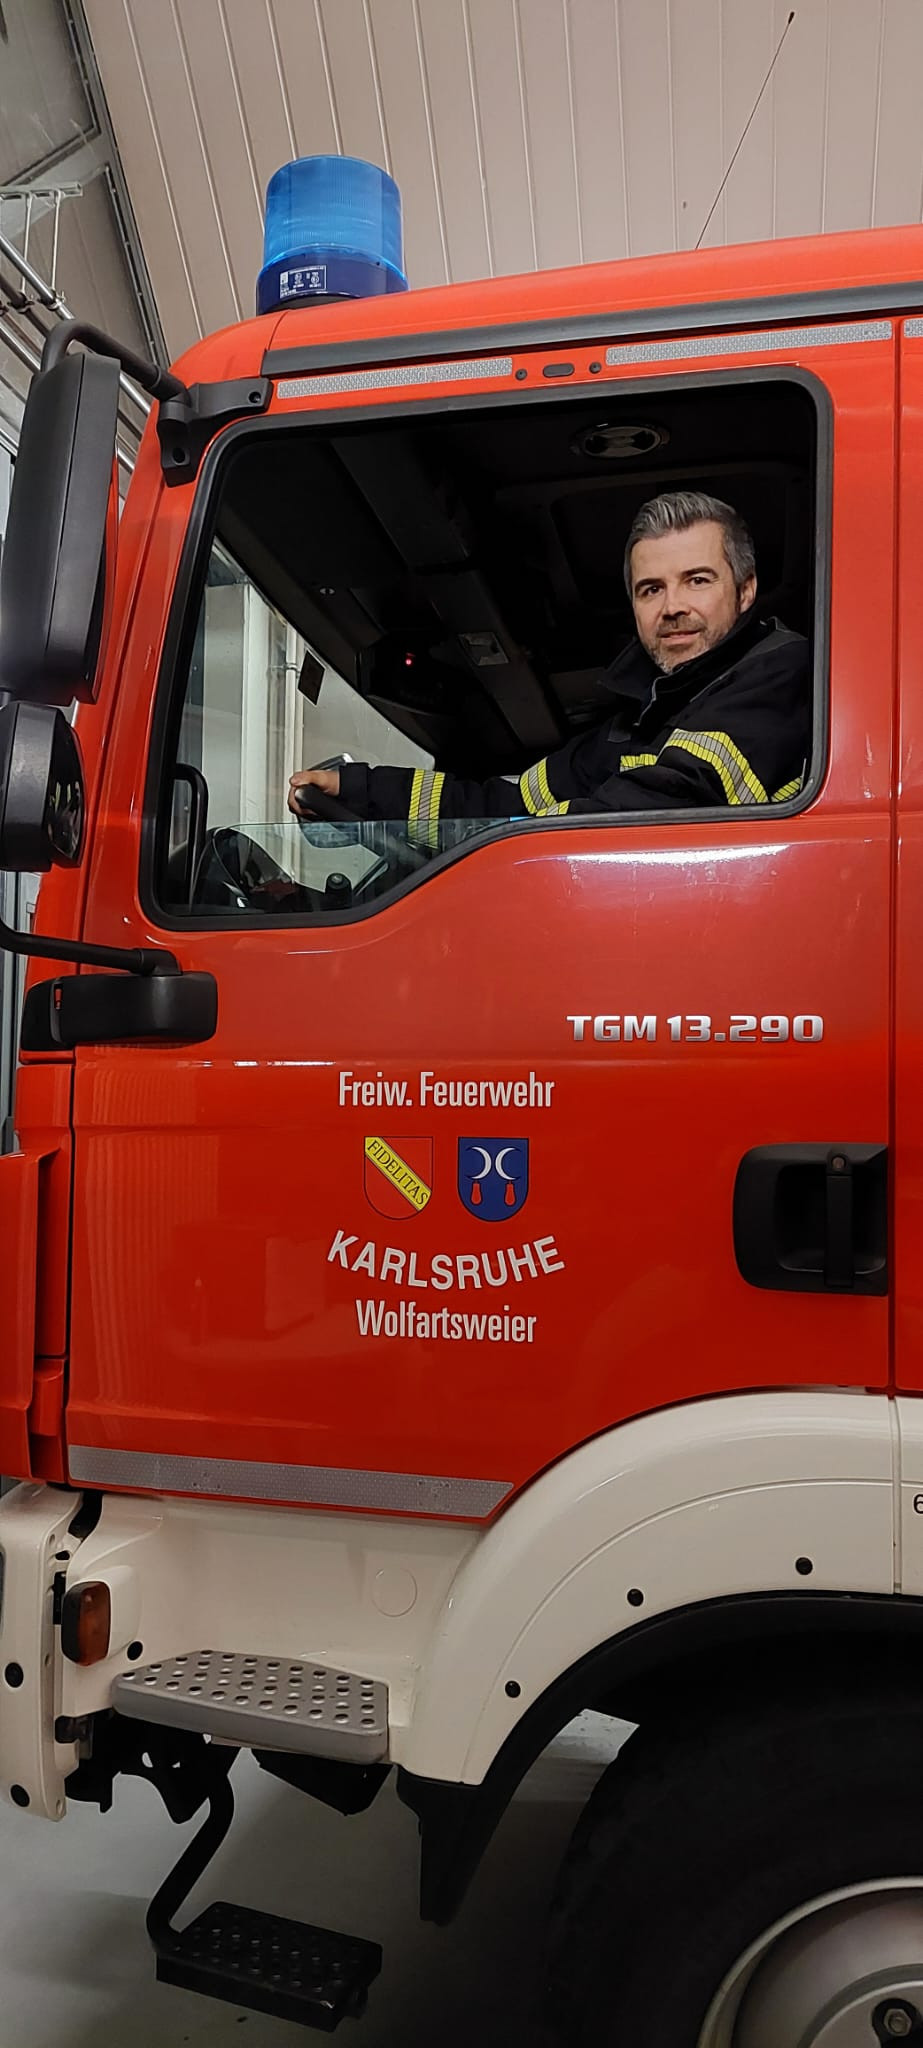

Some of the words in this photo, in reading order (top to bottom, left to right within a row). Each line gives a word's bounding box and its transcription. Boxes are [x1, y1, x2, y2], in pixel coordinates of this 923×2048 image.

[566, 1015, 657, 1042] TGM
[666, 1015, 824, 1042] 13.290
[339, 1071, 413, 1107] Freiw.
[420, 1071, 555, 1108] Feuerwehr
[367, 1140, 429, 1206] FIDELITAS
[327, 1230, 566, 1290] KARLSRUHE
[356, 1299, 537, 1343] Wolfartsweier
